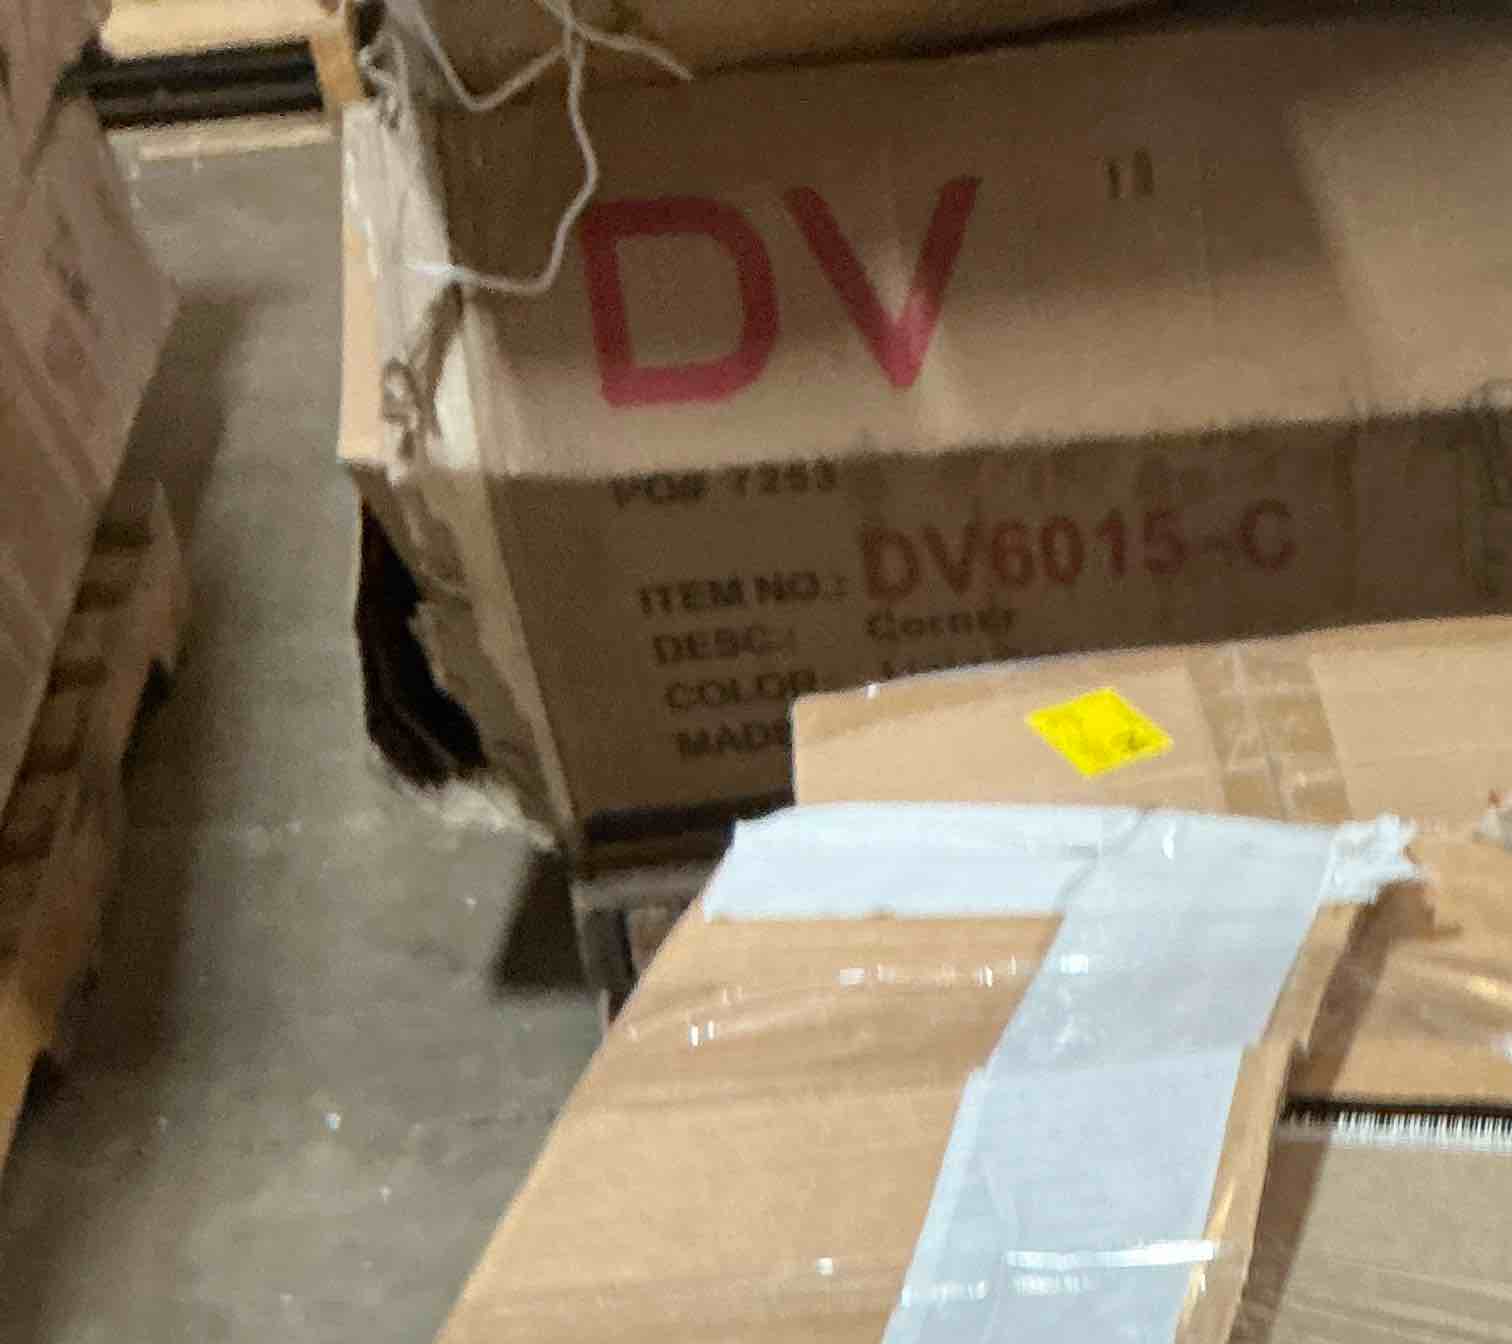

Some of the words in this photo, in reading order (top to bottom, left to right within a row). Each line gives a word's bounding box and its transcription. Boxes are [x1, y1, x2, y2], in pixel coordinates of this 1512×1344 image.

[578, 174, 984, 408] DV
[638, 575, 746, 616] ITEM
[858, 498, 1297, 602] DV6015-C
